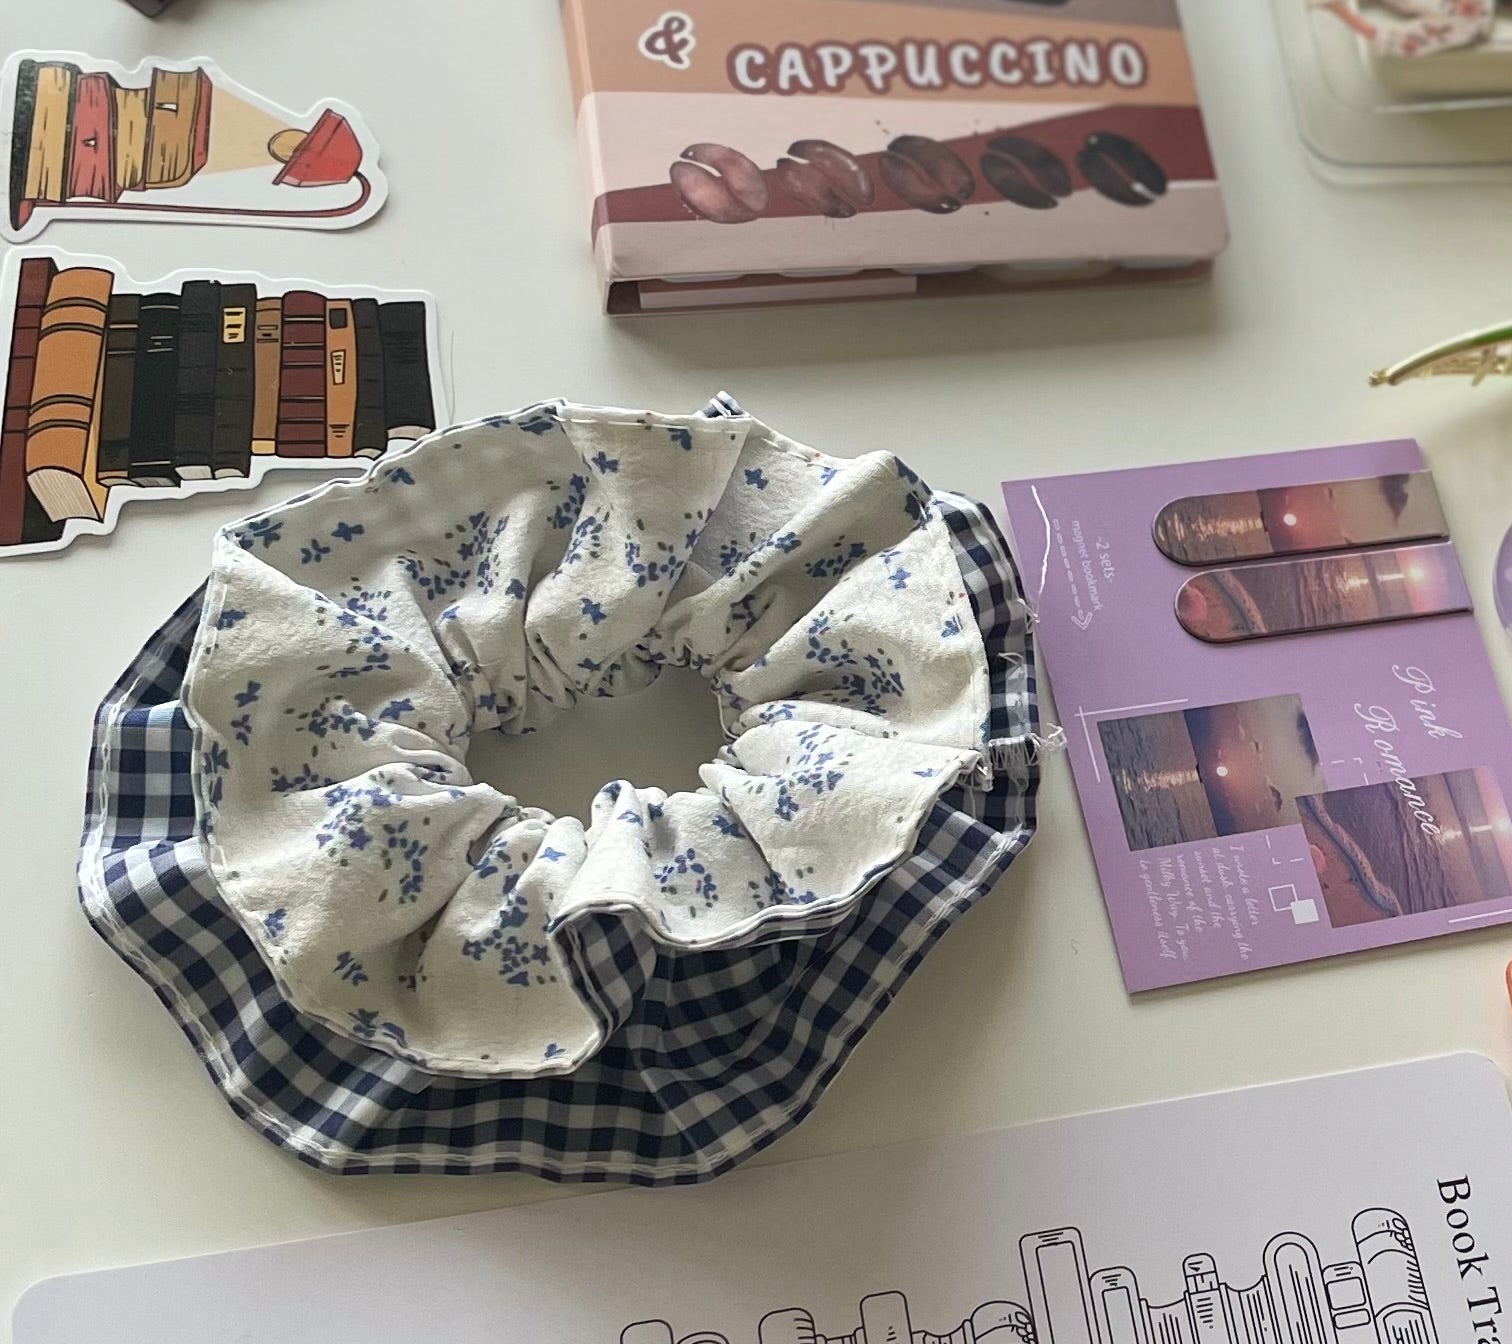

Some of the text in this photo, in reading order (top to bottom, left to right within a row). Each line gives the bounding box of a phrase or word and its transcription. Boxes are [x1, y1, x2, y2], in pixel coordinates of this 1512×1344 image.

[641, 12, 695, 68] &
[733, 40, 1148, 92] CAPPUCCINO
[1071, 520, 1104, 611] magnet bookmark
[1391, 664, 1463, 739] Pink
[1353, 703, 1441, 836] Romance
[1158, 856, 1176, 888] Milky
[1176, 853, 1207, 933] romance of the
[1193, 850, 1225, 929] sunset and the
[1245, 897, 1260, 926] letter
[1237, 941, 1253, 960] the
[1437, 1174, 1488, 1280] Book
